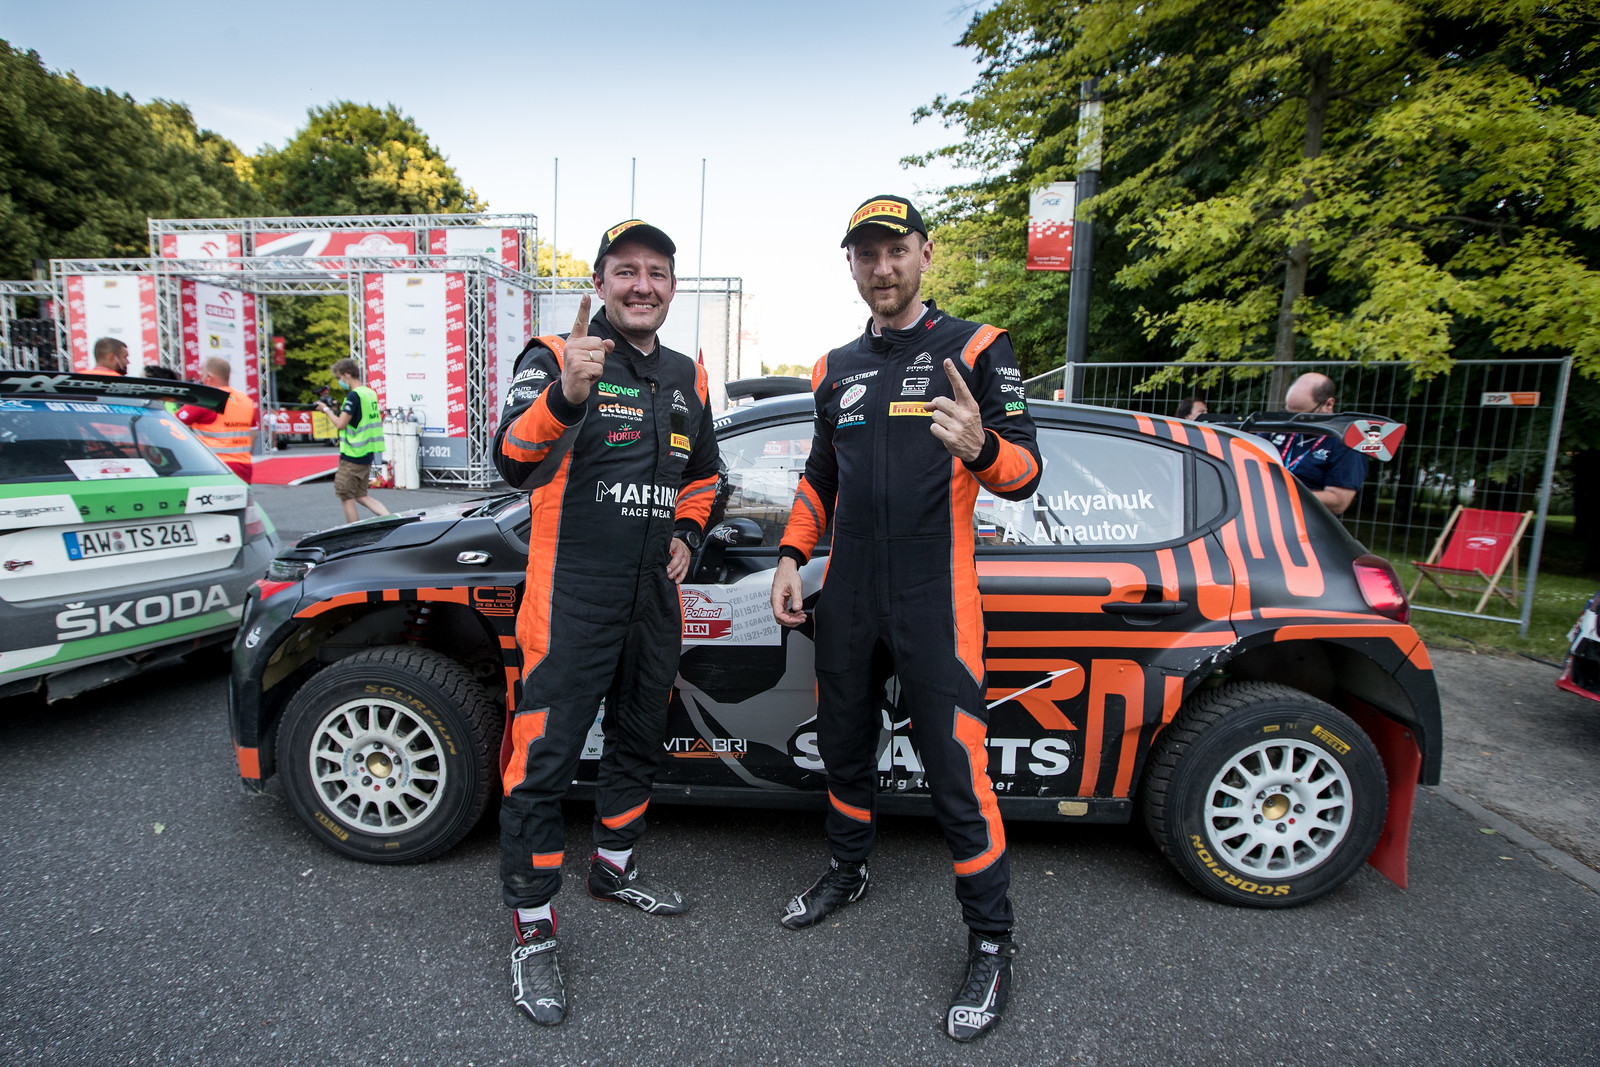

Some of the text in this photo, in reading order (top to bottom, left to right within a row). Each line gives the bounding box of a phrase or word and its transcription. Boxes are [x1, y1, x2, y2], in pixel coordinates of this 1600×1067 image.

[852, 202, 902, 225] PIRELLI
[207, 306, 234, 317] ORLEN
[842, 370, 878, 385] COOLSTREAM
[598, 382, 640, 398] ekover
[598, 403, 644, 417] octane
[607, 430, 640, 443] HORTEX
[596, 481, 678, 508] MARIN
[1033, 489, 1155, 516] Lukyanuk
[0, 506, 64, 516] OKSPORT
[621, 507, 671, 519] RACE WEAR
[1002, 520, 1139, 542] A. Arnautov
[83, 524, 194, 555] AW TS 261
[473, 586, 516, 603] C3
[56, 584, 231, 641] ŠKODA
[684, 608, 722, 618] Poland
[663, 737, 747, 752] VITABRI
[1311, 724, 1351, 755] PIRELLI
[1189, 834, 1291, 896] SCORPION
[981, 942, 998, 952] OMP
[955, 1010, 991, 1027] OMP
